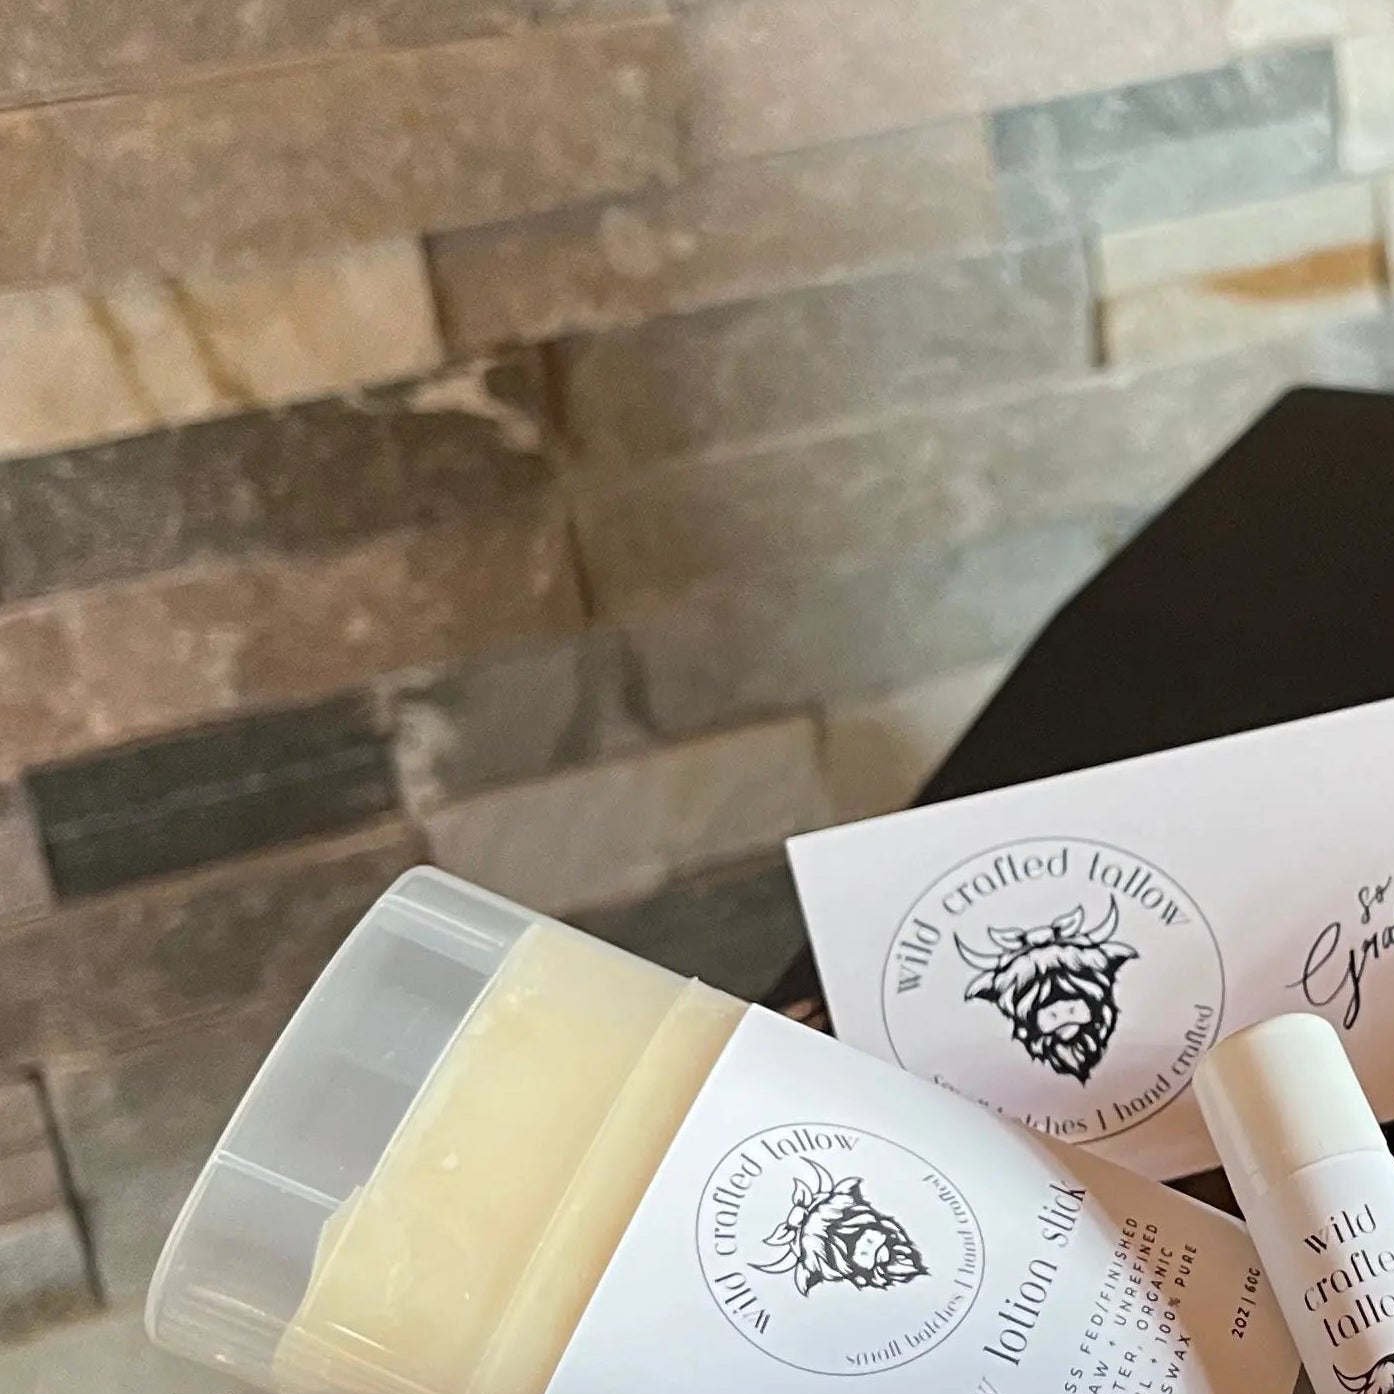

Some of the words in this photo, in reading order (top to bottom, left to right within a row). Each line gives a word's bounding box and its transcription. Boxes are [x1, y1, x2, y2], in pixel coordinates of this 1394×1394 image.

[897, 918, 941, 994] wild
[941, 847, 1069, 916] crafted
[1088, 852, 1192, 926] tallow
[1113, 1074, 1171, 1123] hand
[1172, 1004, 1215, 1077] crafted
[761, 1128, 859, 1161] tallow
[712, 1153, 763, 1257] crafted
[1303, 1203, 1378, 1255] wild
[714, 1271, 771, 1335] wild
[983, 1258, 1058, 1367] lotion
[1038, 1180, 1087, 1248] stick
[1080, 1216, 1138, 1356] FED/FINISHED
[1115, 1223, 1158, 1327] UNREFINED
[1136, 1246, 1174, 1331] ORGANIC
[1155, 1297, 1181, 1344] 100%
[1174, 1244, 1198, 1288] PURE
[846, 1339, 902, 1365] small
[905, 1295, 964, 1348] batches
